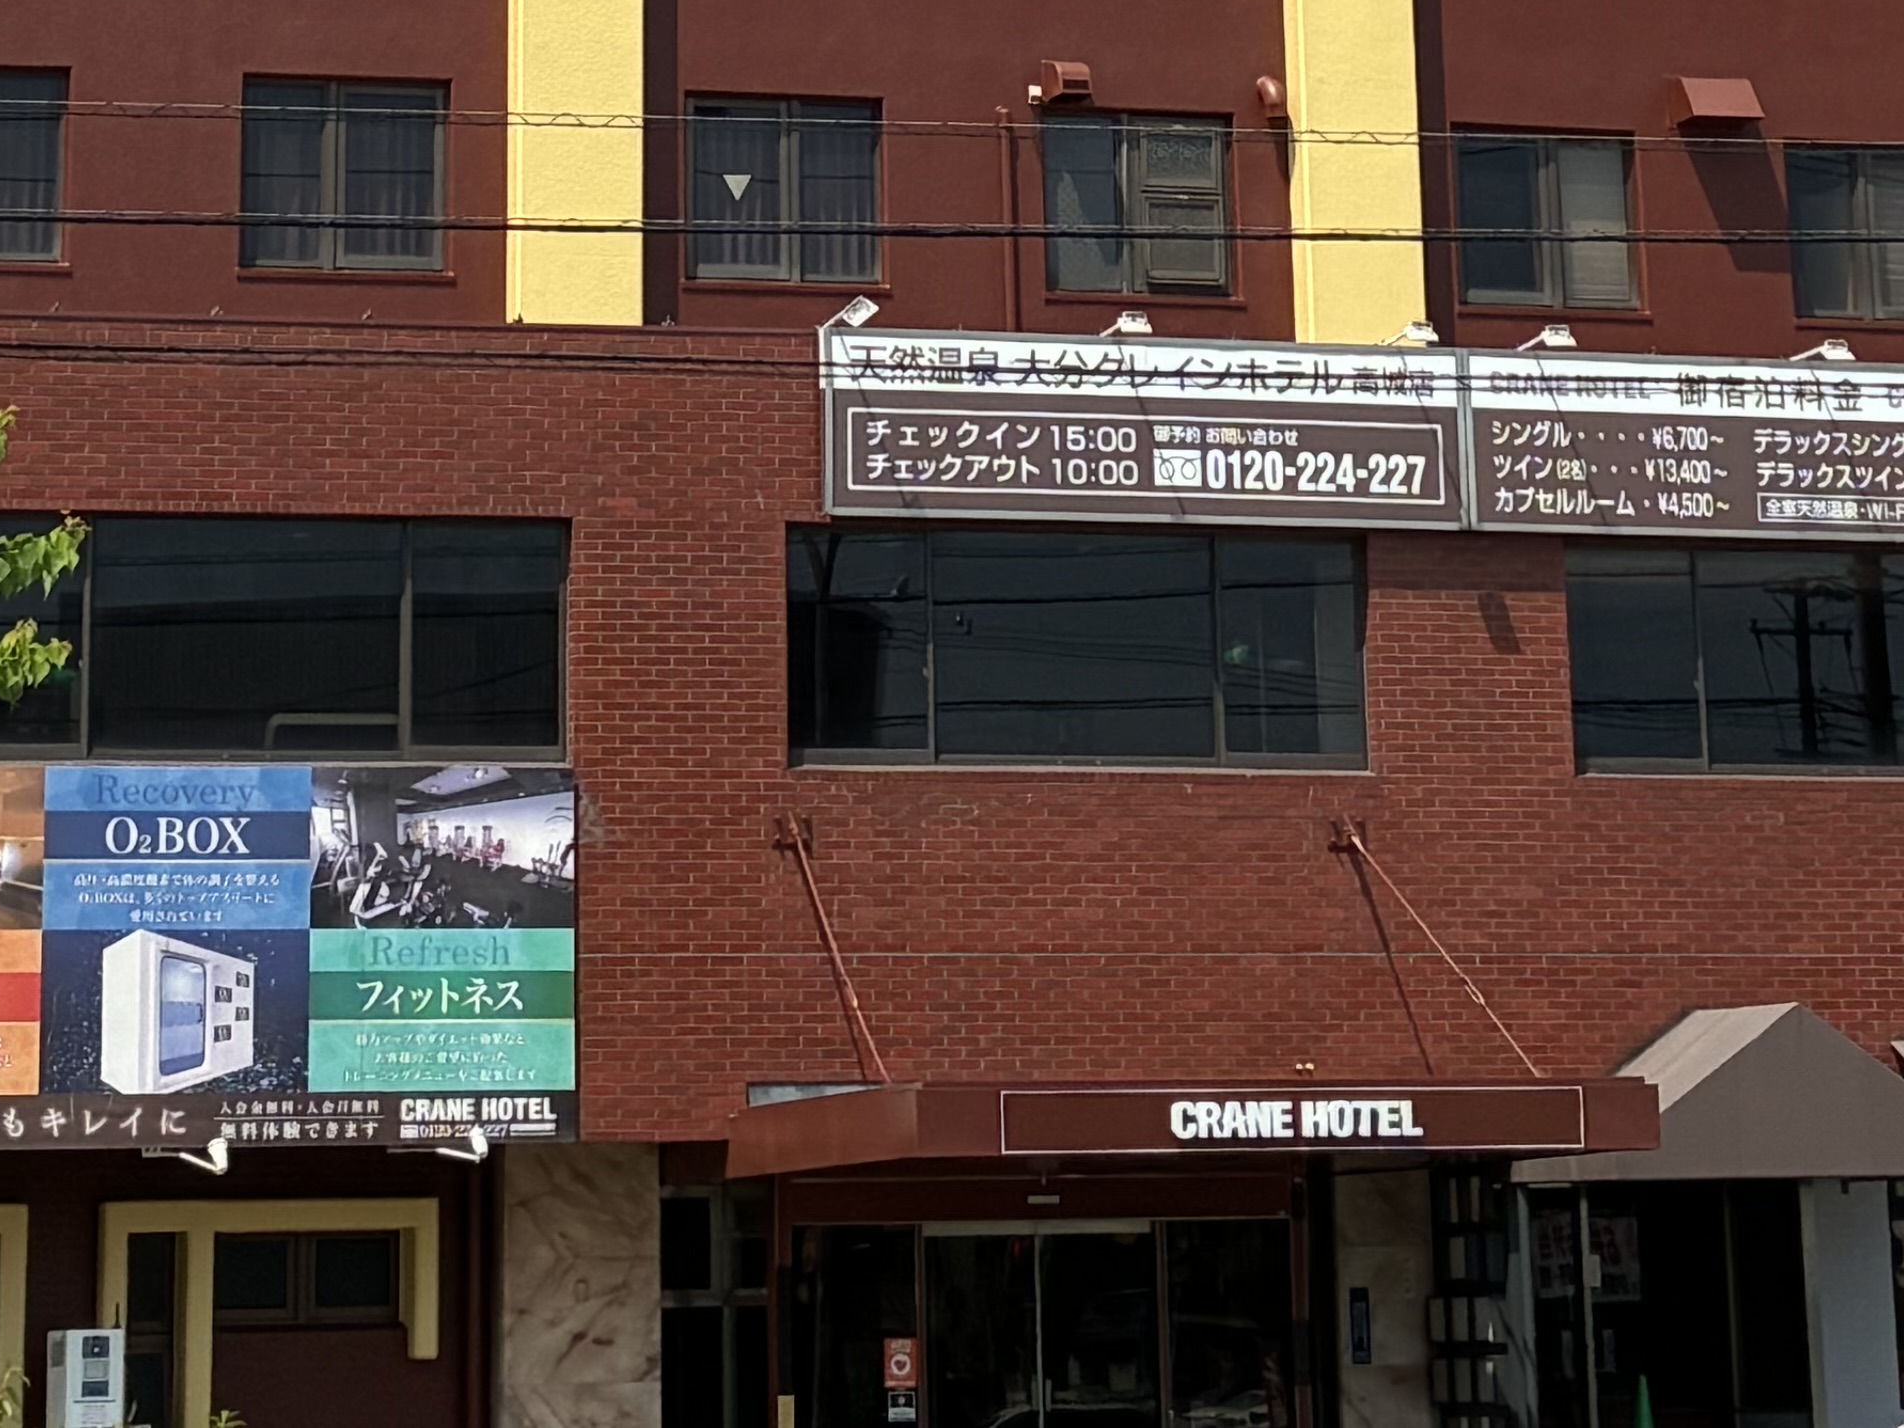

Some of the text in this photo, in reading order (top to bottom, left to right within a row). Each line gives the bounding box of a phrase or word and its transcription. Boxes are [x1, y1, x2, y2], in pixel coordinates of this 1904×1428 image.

[866, 419, 1137, 453] チェックイン 15:00
[1204, 426, 1300, 446] お問い合わせ
[866, 452, 1140, 486] チェックアウト 10:00
[1205, 447, 1427, 496] 0120-224-227
[91, 772, 258, 811] Recovery
[368, 935, 512, 968] Refresh
[355, 976, 525, 1015] フィットネス
[400, 1096, 559, 1122] CRANE HOTEL
[1169, 1099, 1425, 1140] CRANE HOTEL
